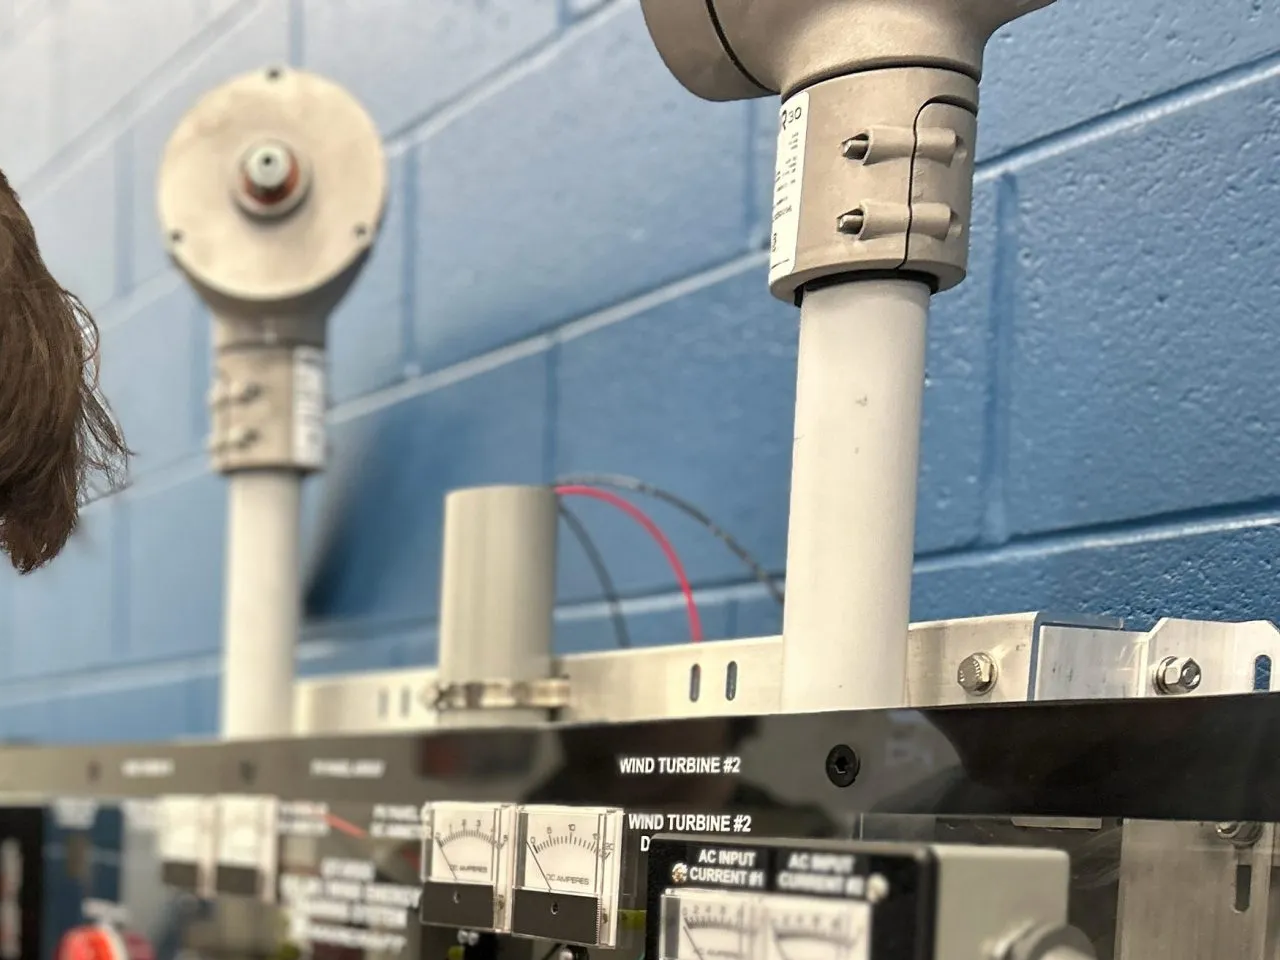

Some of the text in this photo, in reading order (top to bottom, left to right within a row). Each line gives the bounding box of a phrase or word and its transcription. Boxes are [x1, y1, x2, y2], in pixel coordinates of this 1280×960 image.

[620, 756, 741, 773] WIND TURBINE #2
[568, 823, 576, 832] 10
[628, 813, 752, 832] WIND TURBINE #2
[699, 849, 756, 866] AC INPUT
[789, 853, 855, 873] AC INPUT
[556, 874, 590, 885] AMPERES
[690, 867, 764, 887] CURRENT #1
[778, 873, 844, 893] CURRENT
